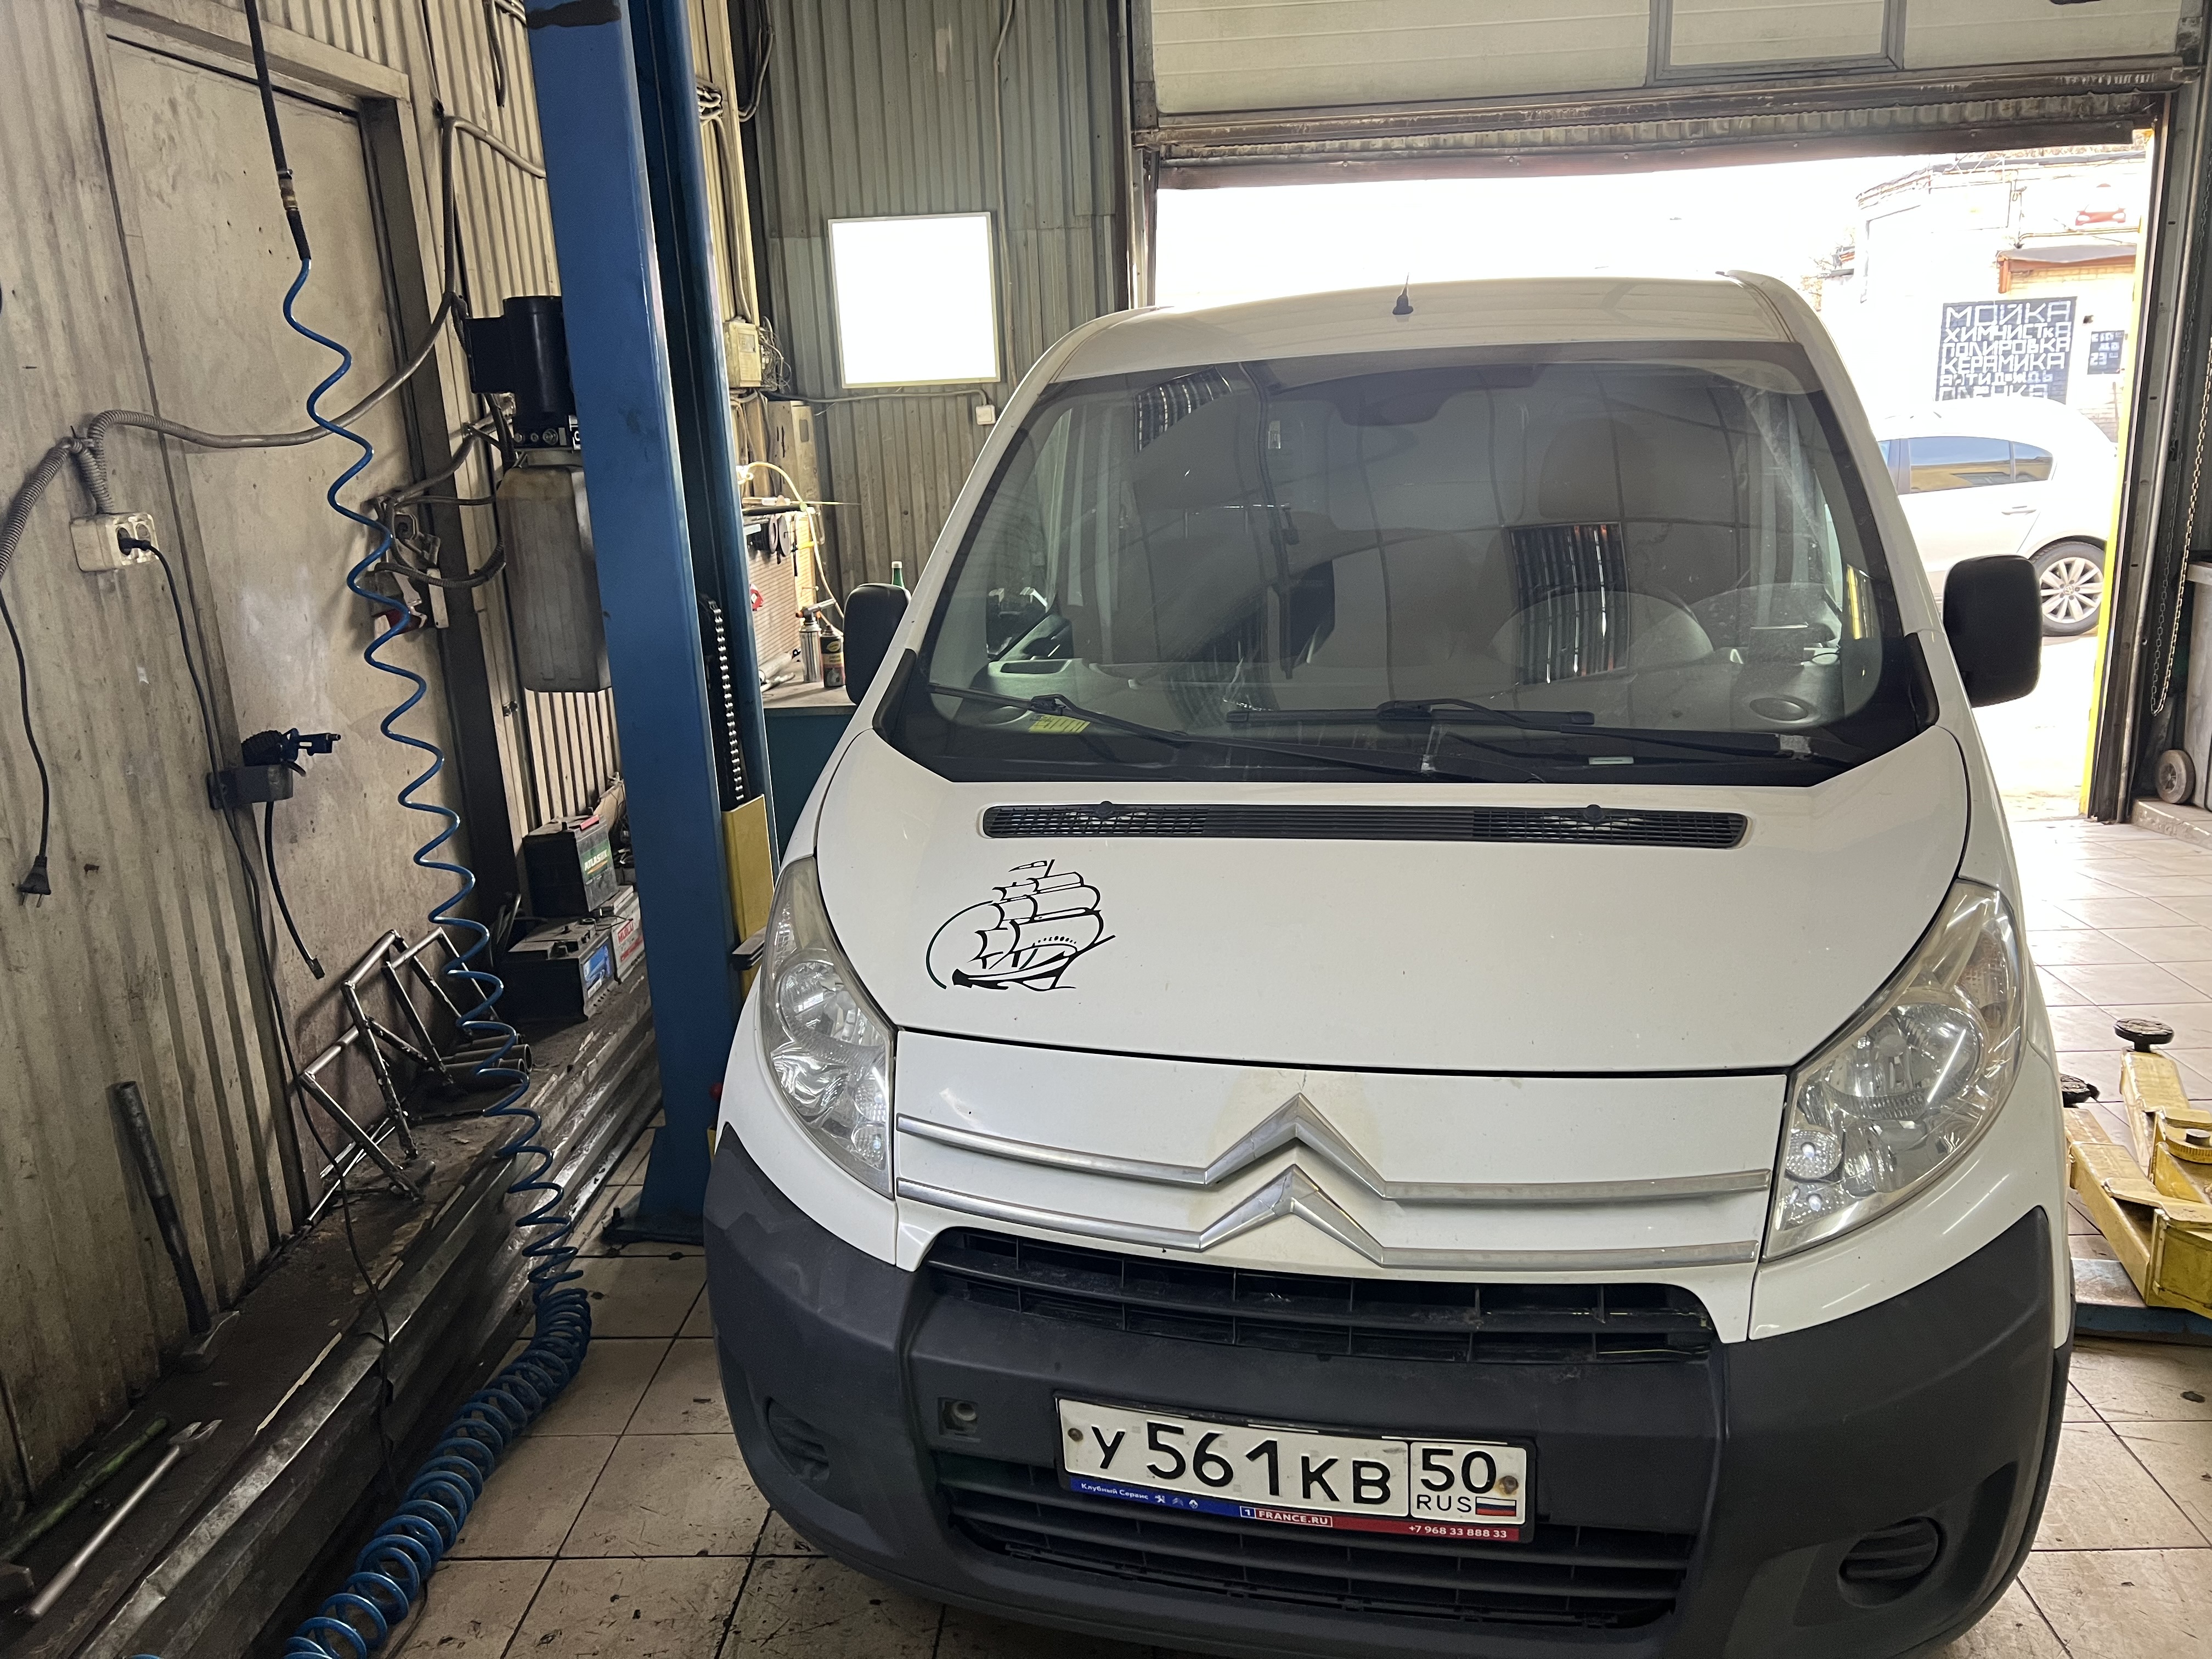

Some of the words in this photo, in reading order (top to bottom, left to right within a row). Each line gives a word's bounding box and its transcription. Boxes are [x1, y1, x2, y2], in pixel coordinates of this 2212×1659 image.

[1945, 301, 2071, 328] МОЙКА
[1942, 337, 2070, 358] ПОЛИРОВКА
[1940, 352, 2065, 375] КЕРАМИКА
[1420, 1448, 1497, 1494] 50
[1081, 1483, 1118, 1494] Клубный
[1119, 1489, 1148, 1500] Сервис
[1417, 1494, 1472, 1513] RUS
[1259, 1510, 1328, 1525] FRANCE.RU
[1409, 1525, 1421, 1533] +7
[1425, 1526, 1447, 1535] 968
[1449, 1527, 1464, 1536] 33
[1467, 1528, 1490, 1538] 888
[1493, 1530, 1507, 1538] 33
